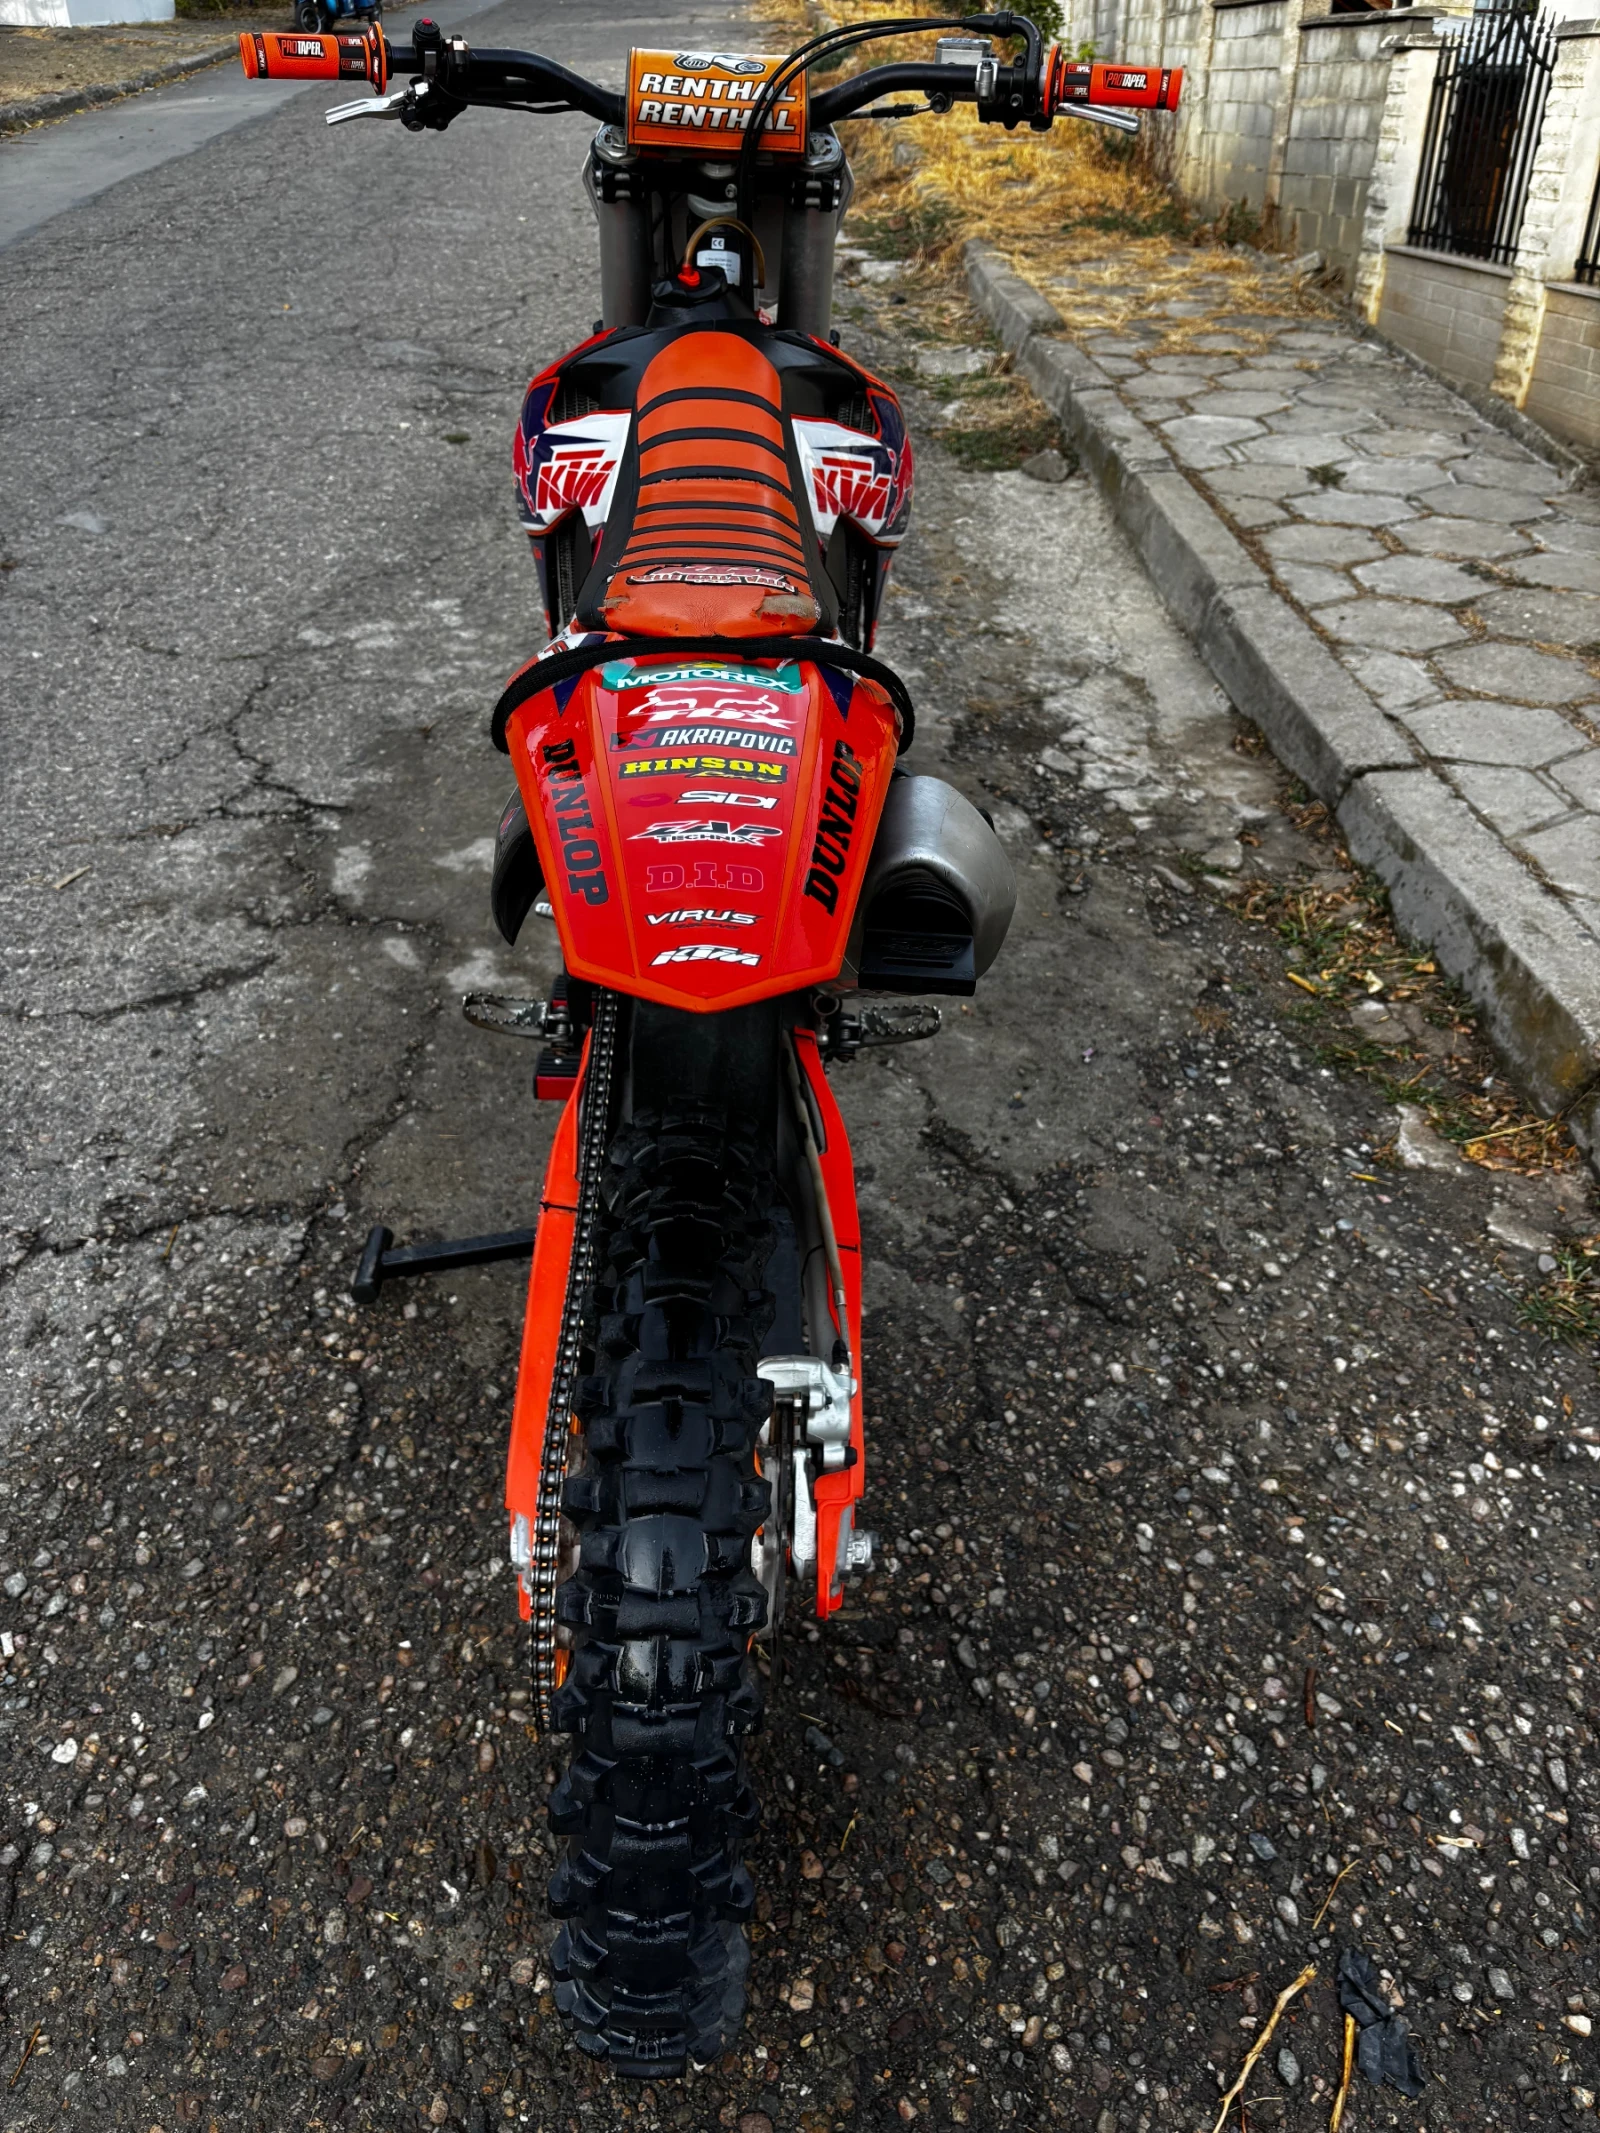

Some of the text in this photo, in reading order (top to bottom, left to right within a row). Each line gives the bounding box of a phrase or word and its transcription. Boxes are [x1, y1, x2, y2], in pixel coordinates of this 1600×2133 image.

[281, 39, 322, 56] PROTAPER
[639, 73, 796, 101] RENTHAL
[1107, 72, 1146, 88] PROTAPER
[637, 100, 796, 131] RENTHAL
[712, 239, 723, 247] CE
[537, 449, 617, 510] KTM
[812, 456, 891, 520] KTM
[617, 669, 791, 691] MOTOREX
[624, 757, 783, 776] HINSON
[677, 791, 778, 809] SIDI
[542, 738, 609, 906] DUNLOP
[628, 820, 783, 841] ZAP
[803, 739, 863, 917] DUNLOP
[657, 834, 765, 846] TECHNIX
[647, 909, 758, 925] VIRUS
[650, 945, 761, 966] KTM
